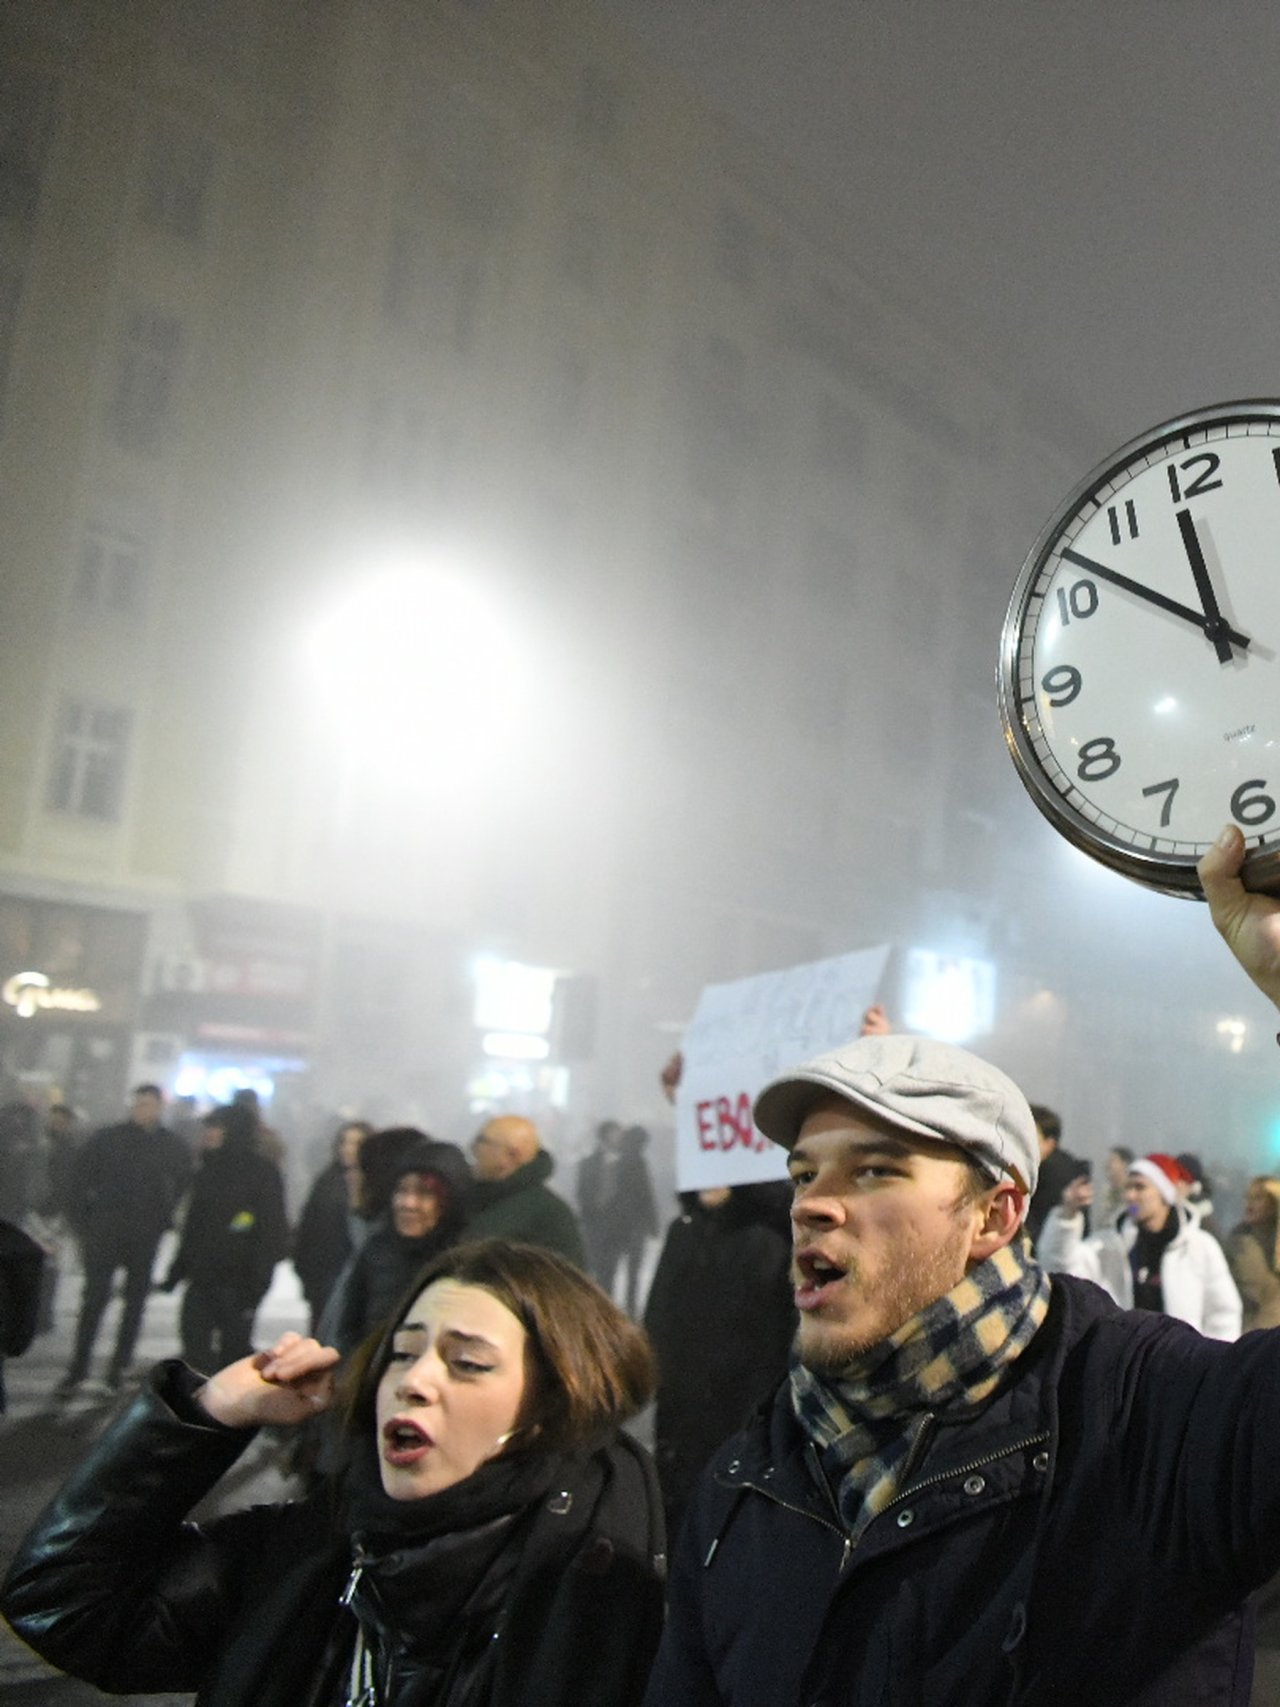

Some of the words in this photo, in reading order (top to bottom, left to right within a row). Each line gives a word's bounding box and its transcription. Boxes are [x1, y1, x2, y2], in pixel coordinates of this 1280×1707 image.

[1168, 452, 1224, 503] 12
[1107, 500, 1140, 546] 11
[1056, 579, 1100, 626] 10
[1041, 664, 1083, 708] 9
[1077, 737, 1122, 782] 8
[1142, 778, 1180, 828] 7
[1230, 780, 1277, 826] 6
